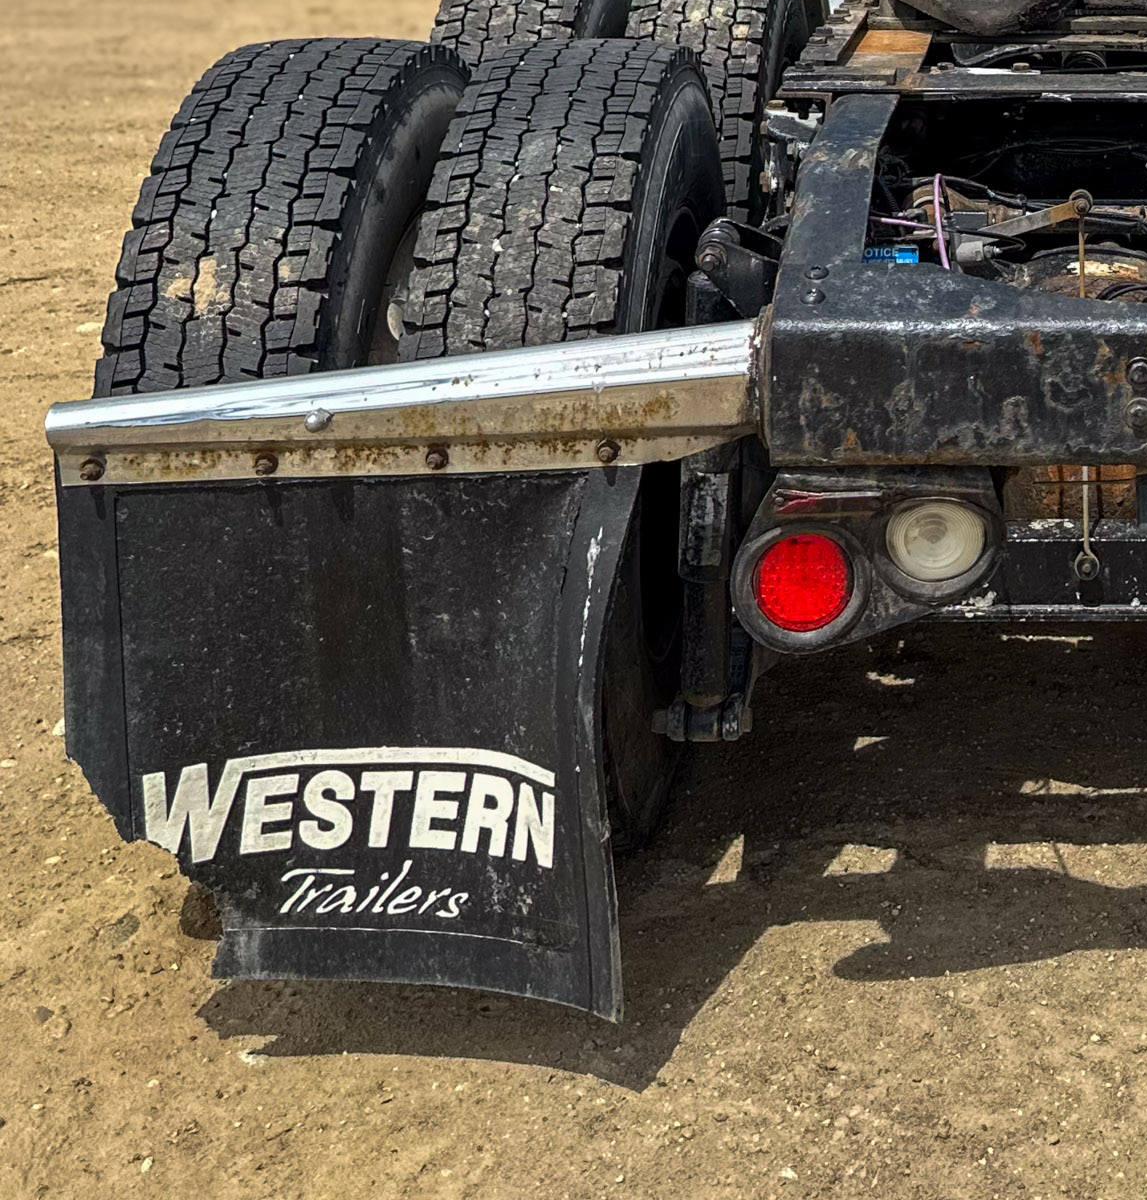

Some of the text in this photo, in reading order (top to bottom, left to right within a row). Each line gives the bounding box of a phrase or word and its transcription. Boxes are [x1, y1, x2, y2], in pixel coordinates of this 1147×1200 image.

[864, 247, 899, 258] OTICE
[142, 746, 556, 869] WESTERN
[280, 860, 468, 919] Trailers
